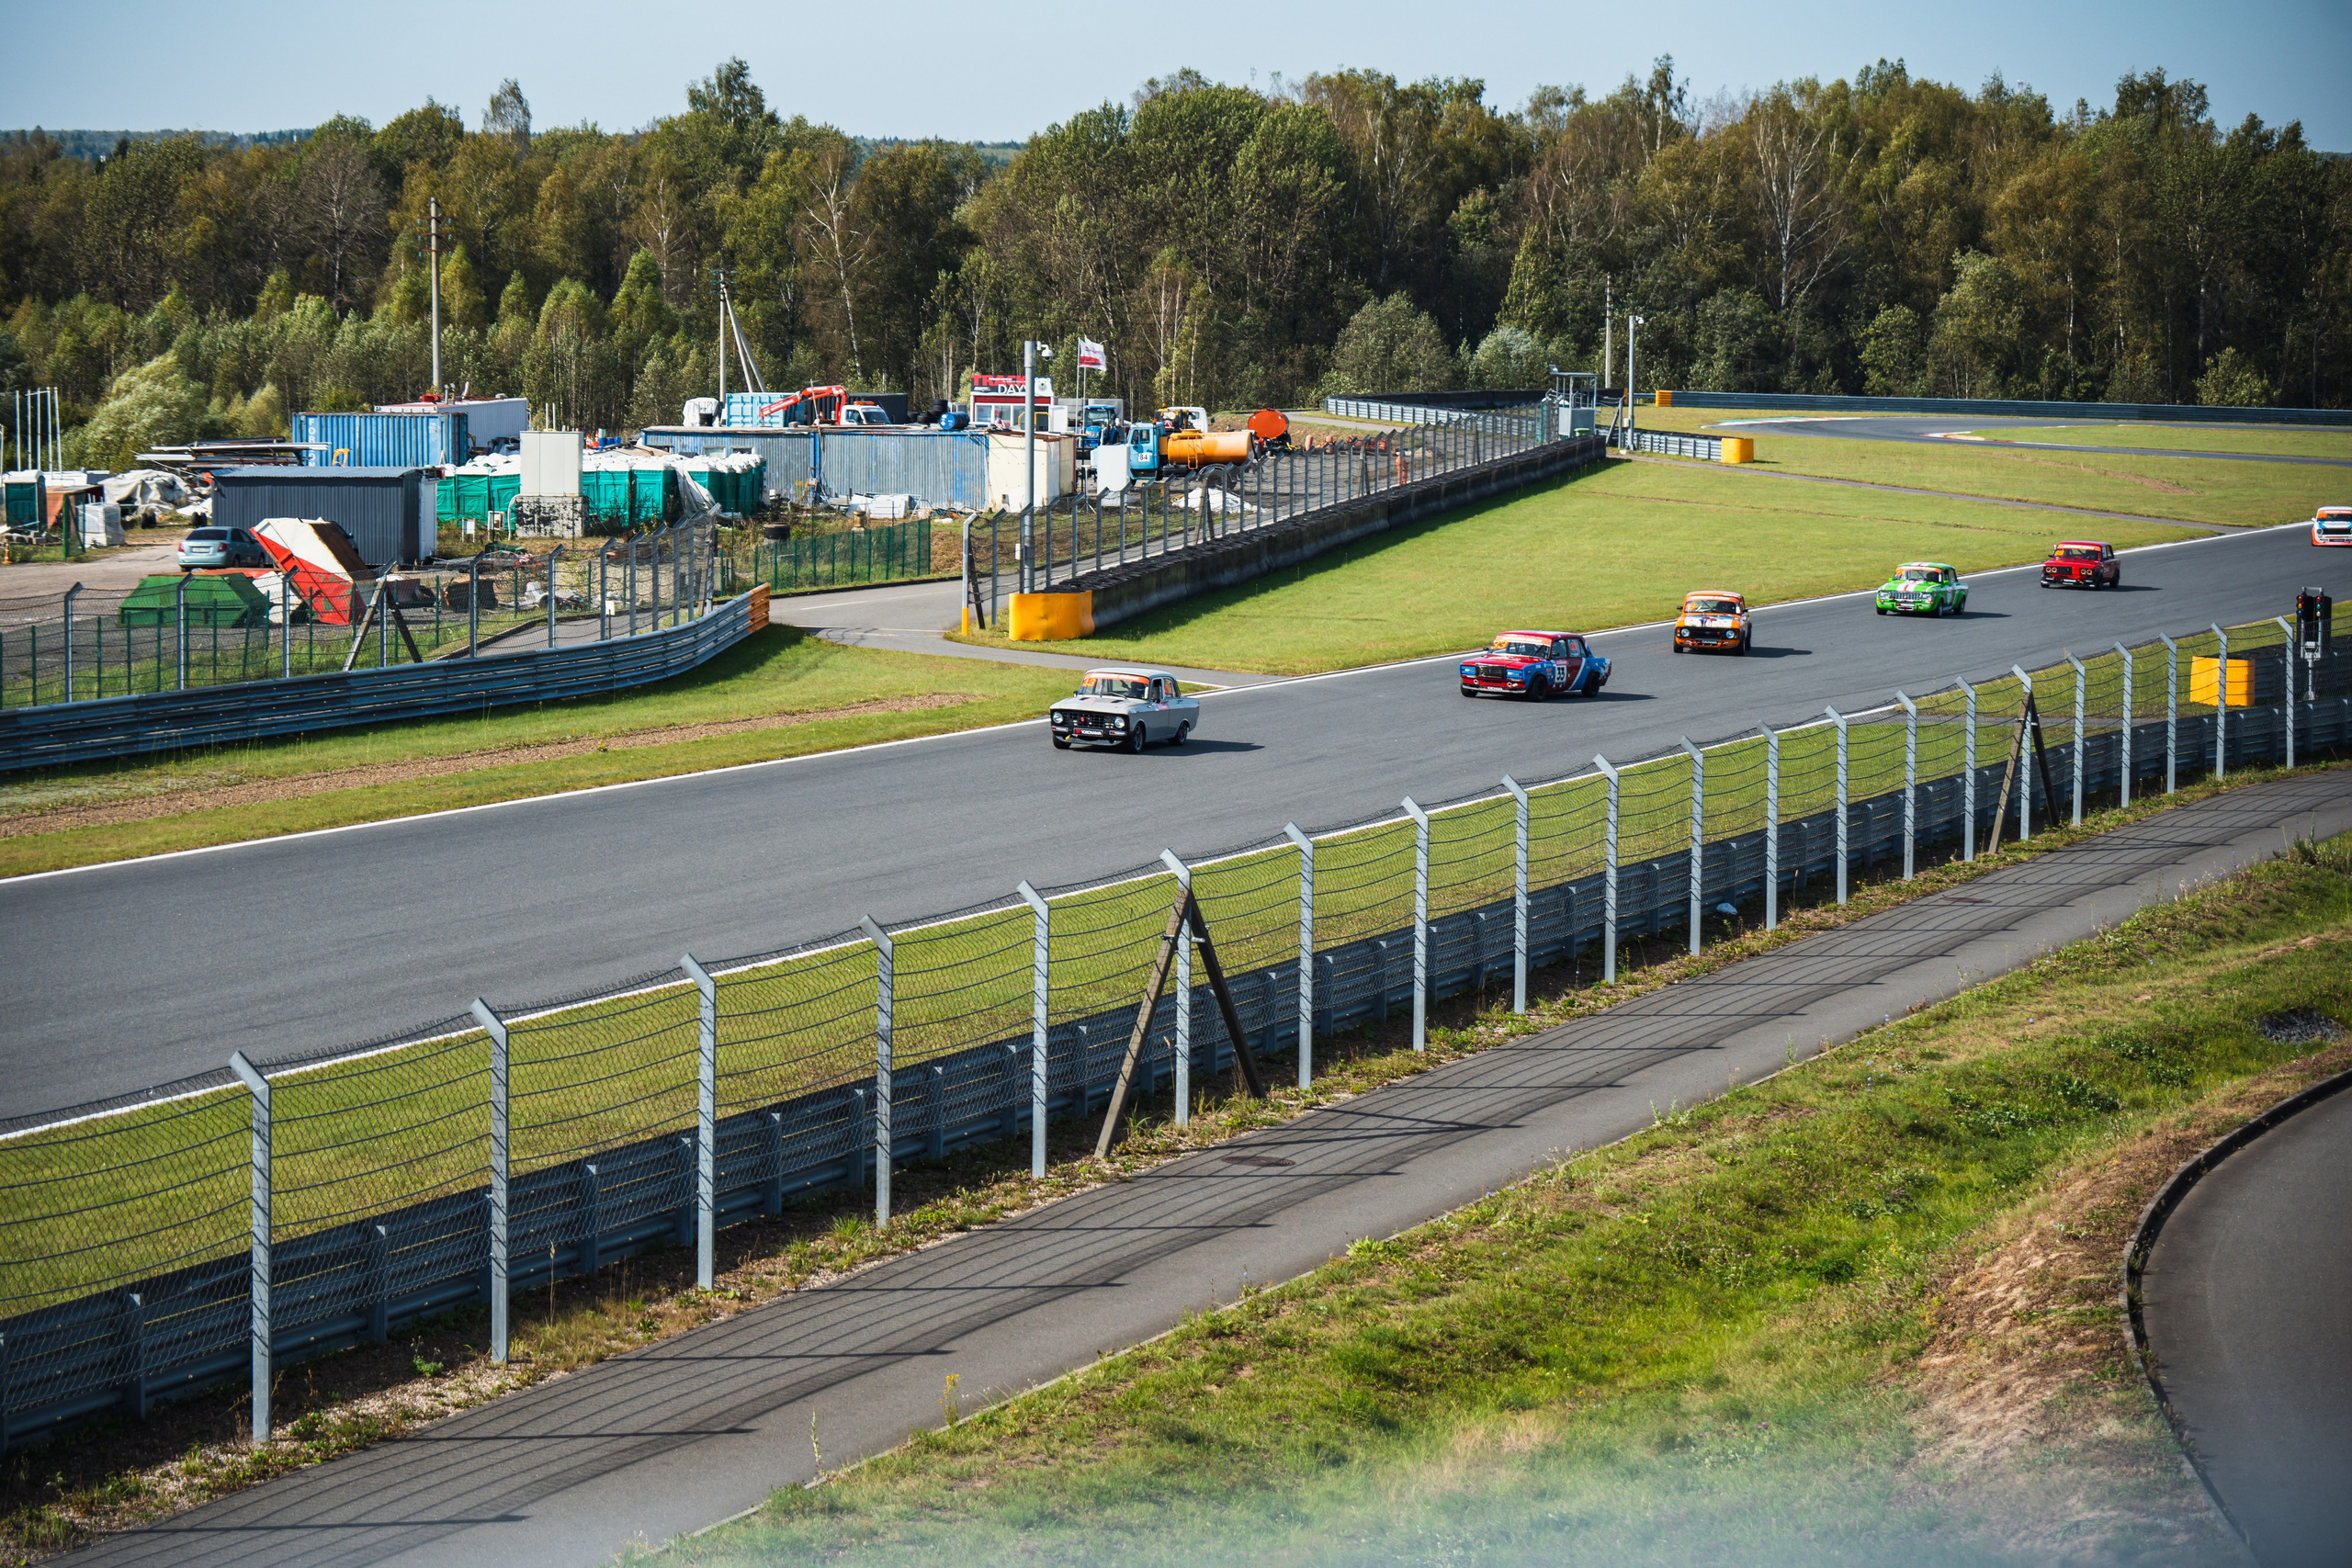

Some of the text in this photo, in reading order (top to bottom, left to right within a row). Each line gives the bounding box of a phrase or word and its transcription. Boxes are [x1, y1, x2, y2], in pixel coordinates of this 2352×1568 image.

[998, 384, 1026, 395] DAY
[1490, 641, 1508, 649] 33
[1556, 667, 1565, 681] 33
[1082, 678, 1097, 687] 43
